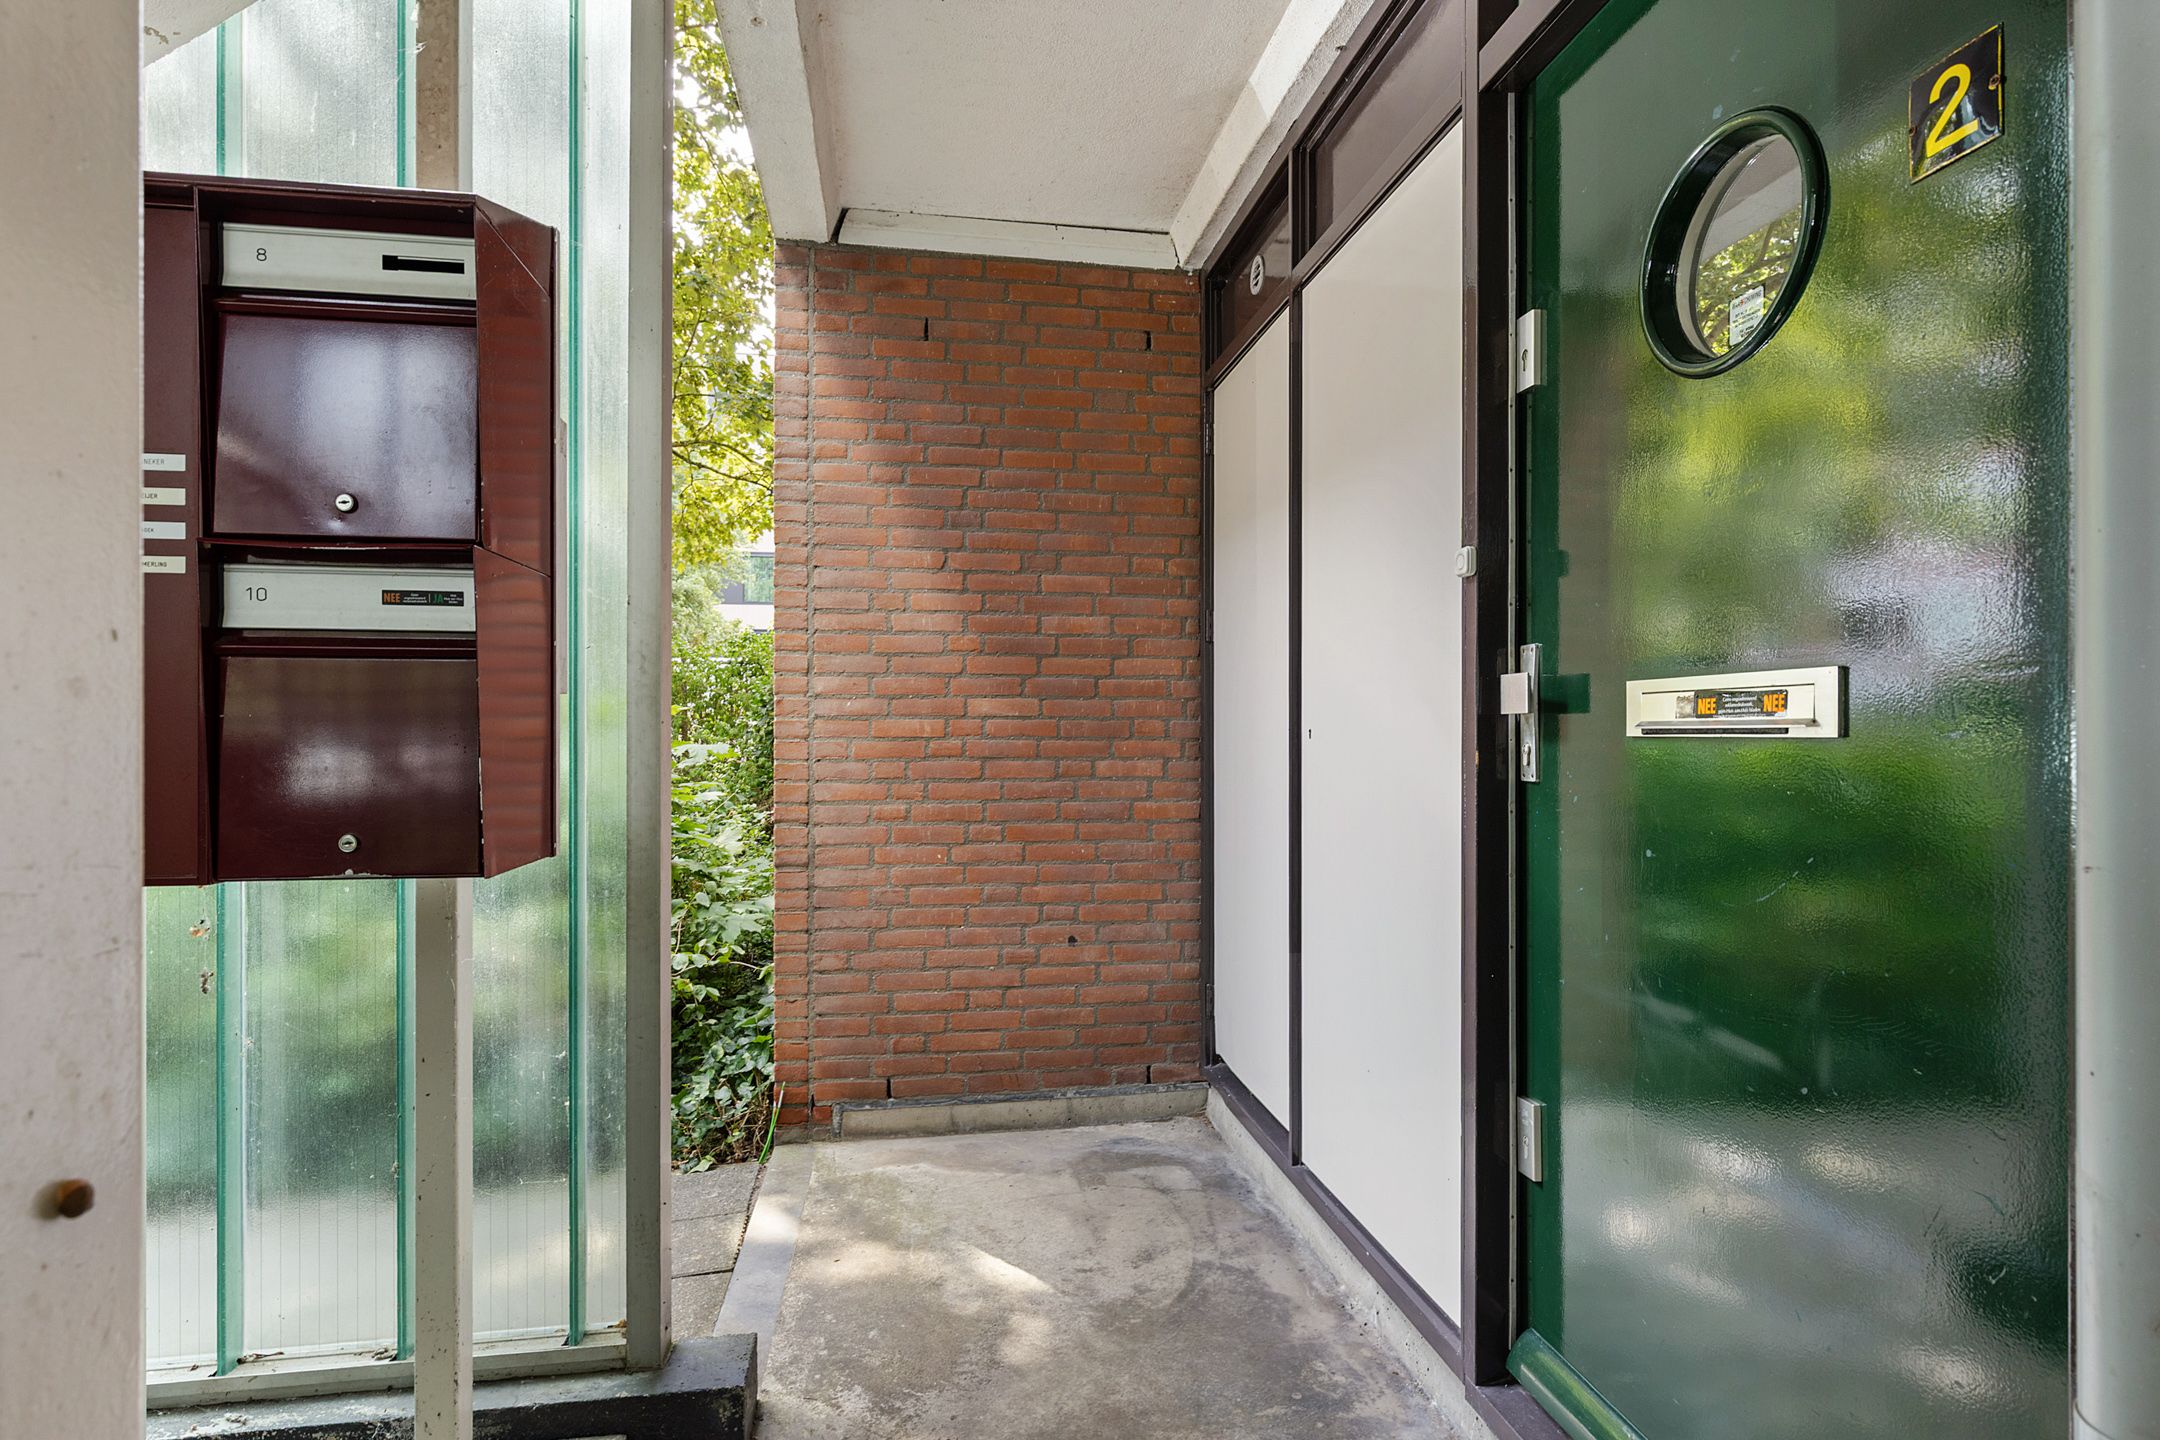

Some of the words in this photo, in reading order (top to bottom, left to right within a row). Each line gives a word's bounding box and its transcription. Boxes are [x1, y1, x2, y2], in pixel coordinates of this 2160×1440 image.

[1925, 63, 1980, 158] 2
[256, 247, 267, 262] 8
[245, 586, 267, 601] 10
[383, 592, 401, 603] NEE
[433, 593, 444, 603] JA
[1697, 697, 1717, 715] NEE
[1763, 693, 1785, 713] NEE
